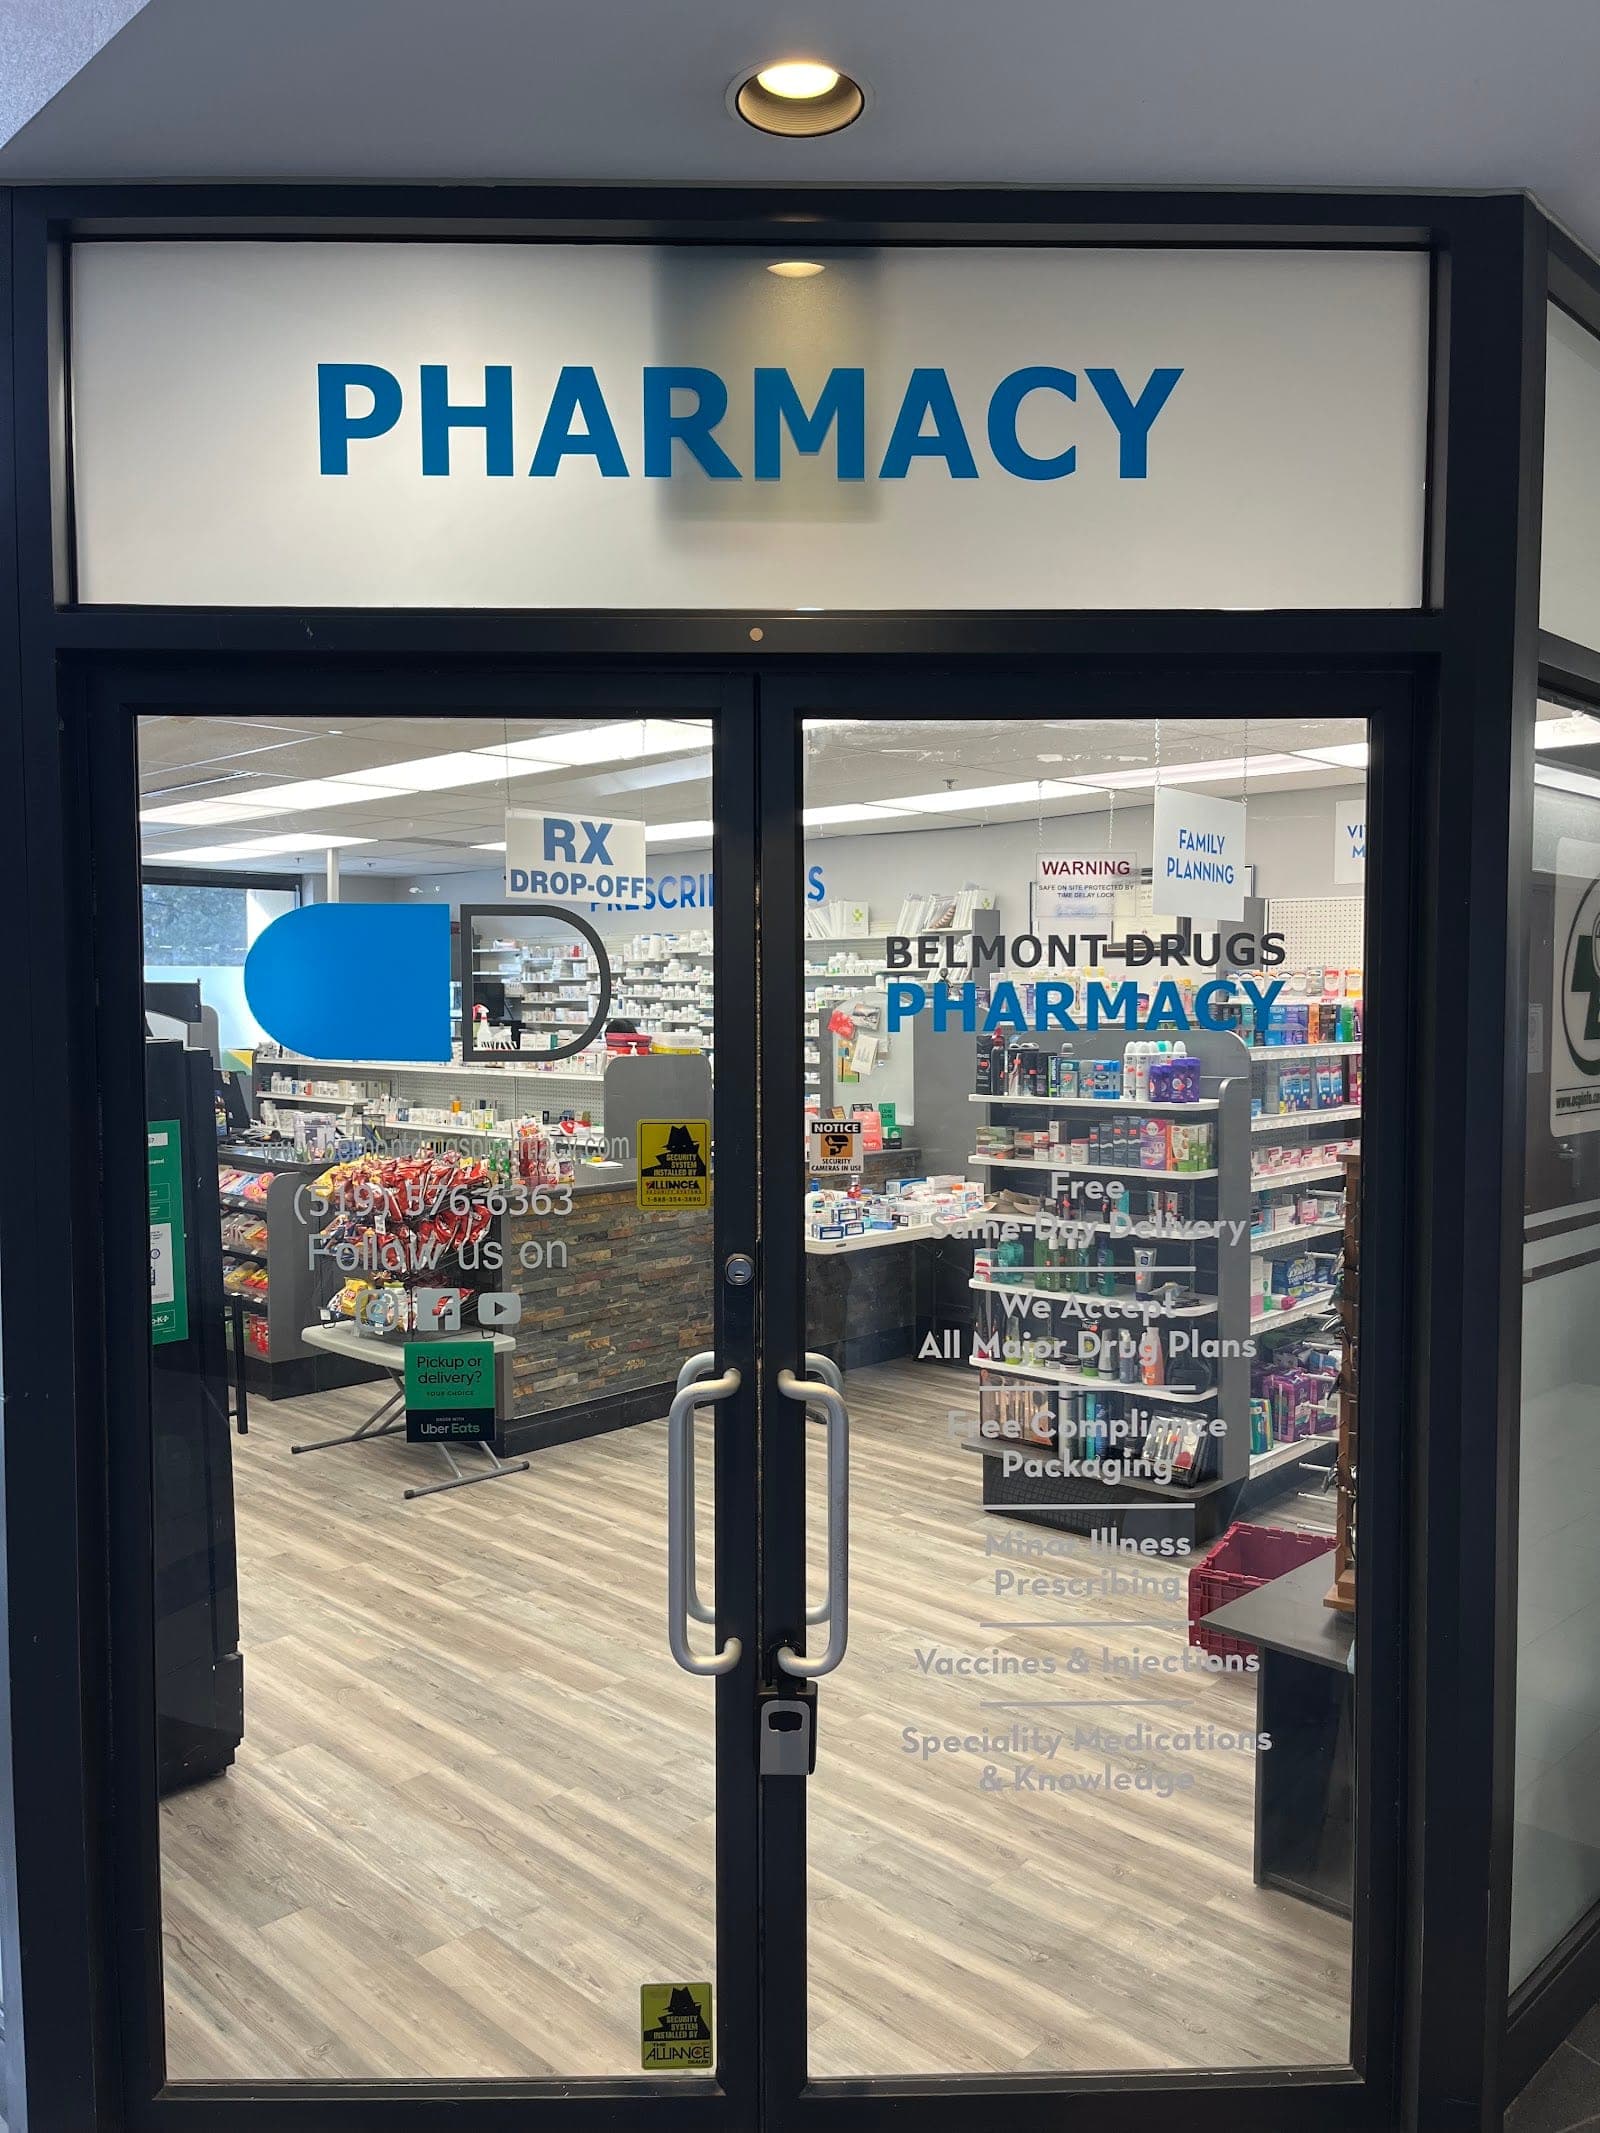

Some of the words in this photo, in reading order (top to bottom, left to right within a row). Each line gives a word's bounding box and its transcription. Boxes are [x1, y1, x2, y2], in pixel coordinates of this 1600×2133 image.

[318, 363, 1185, 481] PHARMACY
[543, 818, 614, 866] RX
[1179, 829, 1225, 855] FAMILY
[1042, 860, 1130, 876] WARNING
[1167, 857, 1234, 885] PLANNING
[510, 868, 644, 899] DROP-OFF
[886, 934, 1108, 968] BELMONT
[1124, 932, 1287, 967] DRUGS
[887, 980, 1286, 1033] PHARMACY
[814, 1123, 860, 1133] NOTICE
[666, 1153, 697, 1161] SECURITY
[671, 1161, 697, 1169] SYSTEM
[653, 1169, 687, 1177] INSTALLED
[1051, 1171, 1126, 1200] Free
[293, 1183, 391, 1224] (519)
[408, 1184, 574, 1216] 576-6363
[930, 1211, 1096, 1246] Same-Day
[1109, 1209, 1247, 1246] Delivery
[308, 1232, 441, 1272] Follow
[458, 1242, 503, 1270] us
[520, 1239, 567, 1269] on
[1000, 1291, 1051, 1319] We
[1060, 1291, 1178, 1326] Accept
[918, 1330, 961, 1359] All
[973, 1328, 1067, 1366] Major
[1077, 1331, 1158, 1366] Drug
[1168, 1330, 1257, 1359] Plans
[416, 1355, 464, 1370] Pickup
[467, 1357, 482, 1367] or
[418, 1370, 482, 1386] delivery?
[420, 1423, 449, 1434] Uber
[451, 1422, 481, 1434] Eats
[949, 1410, 1022, 1438] Free
[1030, 1408, 1228, 1446] Compliance
[1003, 1450, 1173, 1486] Packaging
[984, 1530, 1080, 1557] Minor
[1091, 1527, 1192, 1557] Illness
[994, 1566, 1181, 1600] Prescribing
[914, 1648, 1057, 1676] Vaccines
[1066, 1647, 1090, 1675] &
[1102, 1646, 1261, 1680] Injections
[901, 1724, 1063, 1761] Speciality
[1073, 1723, 1273, 1752] Medications
[978, 1764, 1003, 1793] &
[1015, 1764, 1196, 1799] Knowledge
[666, 2015, 698, 2023] SECURITY
[671, 2023, 698, 2031] SYSTEM
[653, 2031, 688, 2039] INSTALLED
[646, 2046, 710, 2061] ALLIANCE
